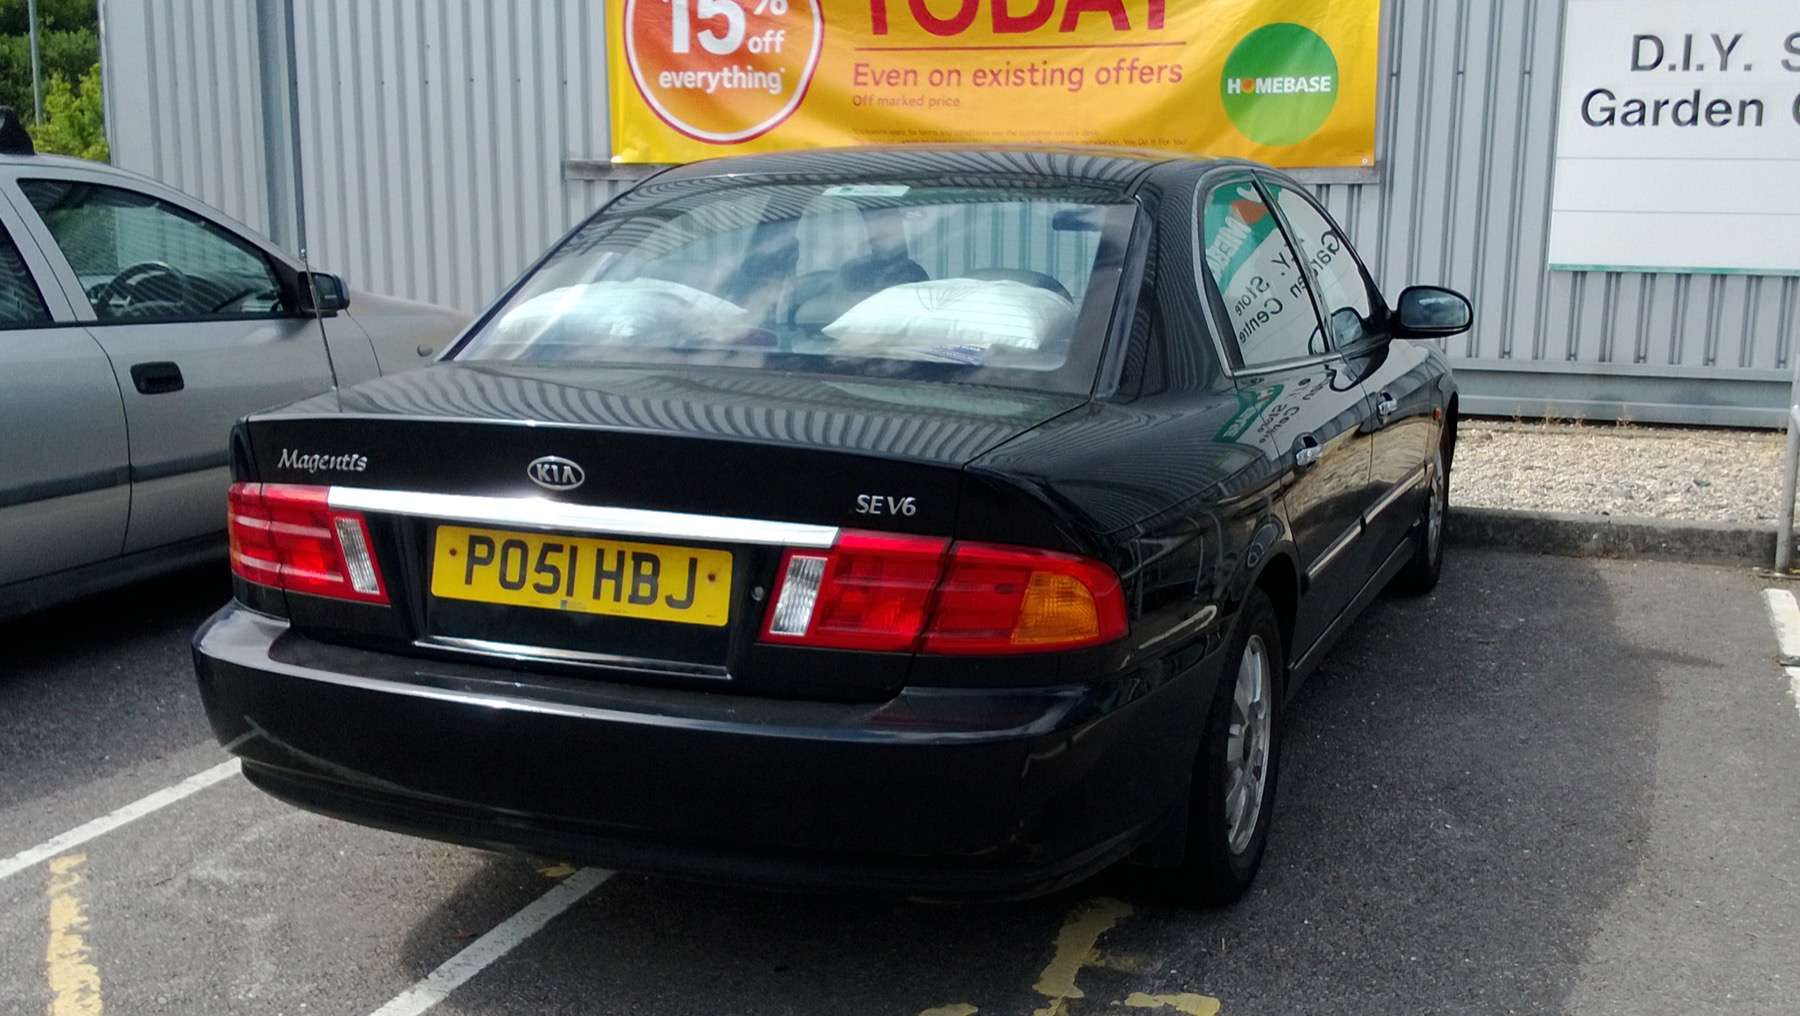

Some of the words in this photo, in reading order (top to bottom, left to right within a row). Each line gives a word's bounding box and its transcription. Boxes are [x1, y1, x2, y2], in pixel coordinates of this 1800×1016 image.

[747, 29, 785, 54] off
[1630, 33, 1752, 72] D.I.Y.
[852, 62, 917, 87] Even
[927, 67, 962, 87] on
[971, 60, 1084, 92] existing
[1095, 57, 1183, 86] offers
[1227, 75, 1331, 95] HOMEBASE
[852, 95, 873, 107] Off
[877, 95, 924, 108] marked
[927, 96, 961, 111] price
[1581, 88, 1764, 127] Garden
[278, 448, 368, 474] Magentis
[534, 461, 578, 485] KIA
[855, 494, 884, 515] SE
[886, 496, 917, 517] V6
[592, 548, 698, 610] HBJ
